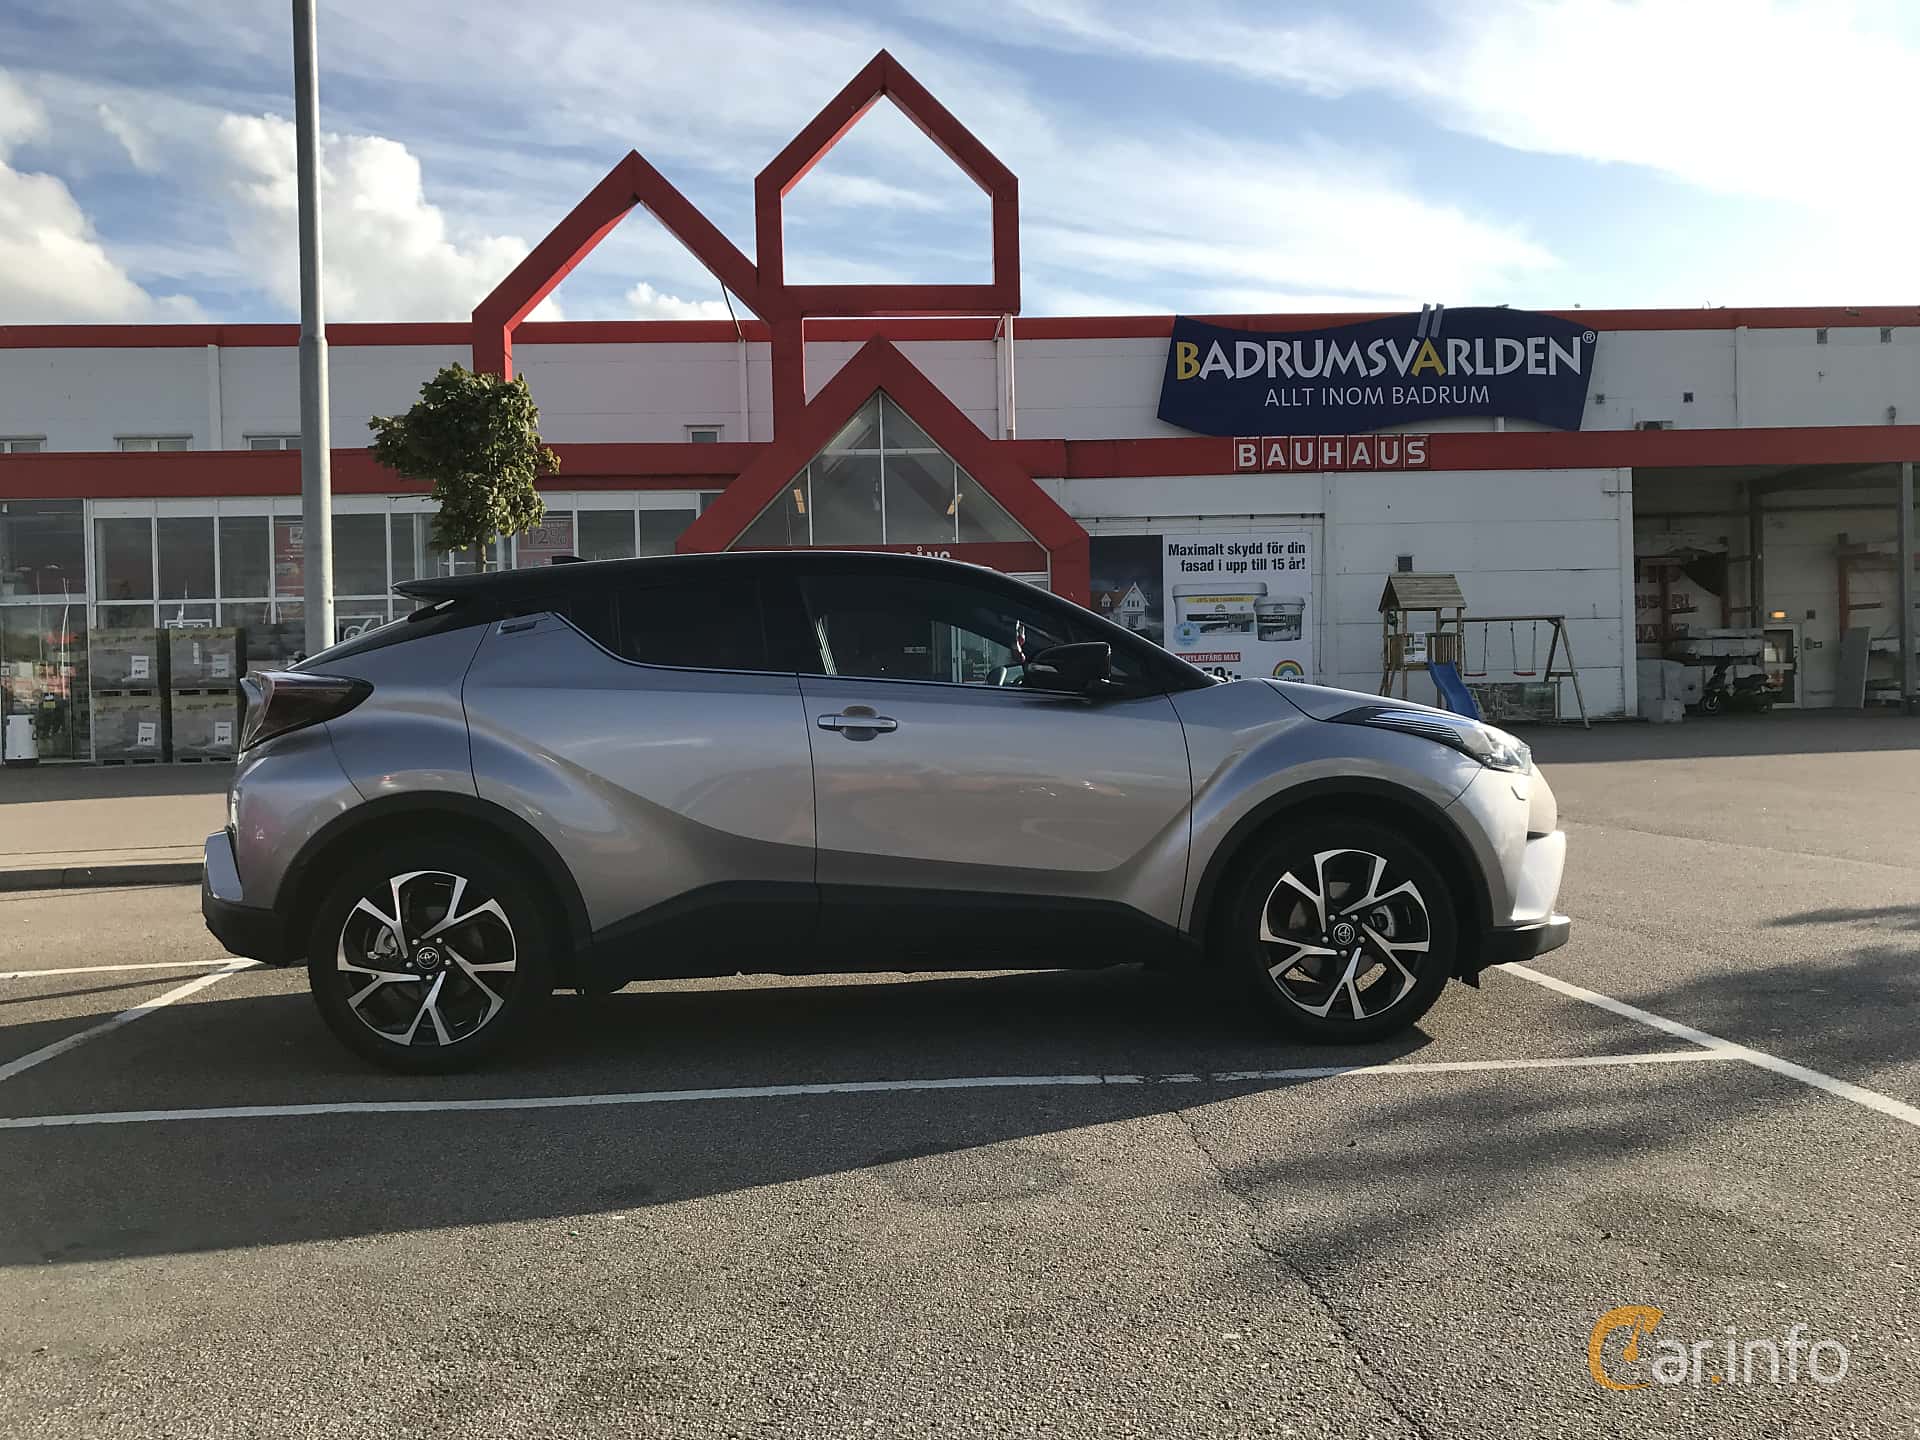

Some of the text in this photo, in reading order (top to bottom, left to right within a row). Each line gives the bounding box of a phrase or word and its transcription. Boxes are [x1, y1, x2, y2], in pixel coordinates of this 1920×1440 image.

[1264, 385, 1490, 407] ALLT INOM BADRUM
[1238, 440, 1426, 467] BAUHAUS
[1168, 541, 1306, 557] Maximalt skydd för din
[1181, 556, 1306, 573] fasad i upp till 15 år!
[1223, 653, 1240, 661] MAX
